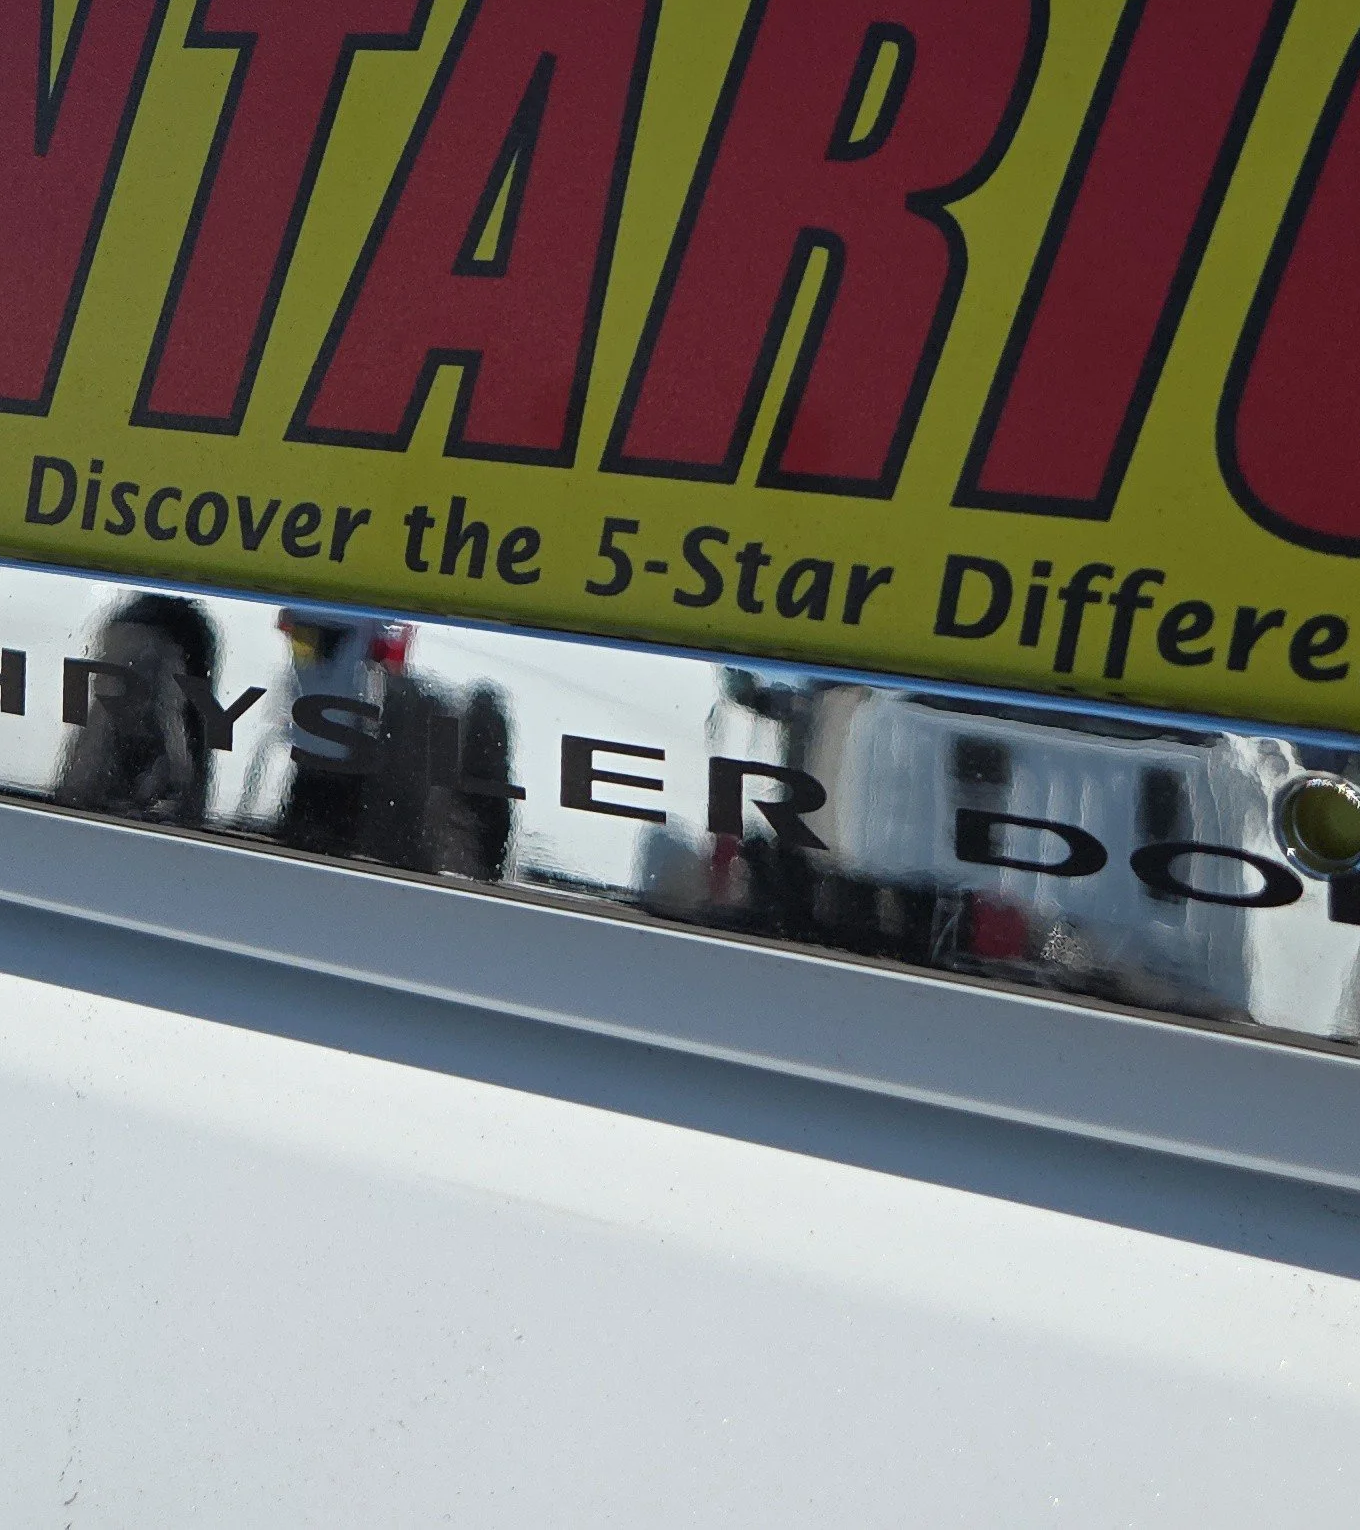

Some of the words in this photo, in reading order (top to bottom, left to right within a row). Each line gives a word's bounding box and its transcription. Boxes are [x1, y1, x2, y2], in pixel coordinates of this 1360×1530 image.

[23, 454, 372, 564] Discover
[404, 494, 545, 584] the
[584, 516, 895, 628] 5-Star
